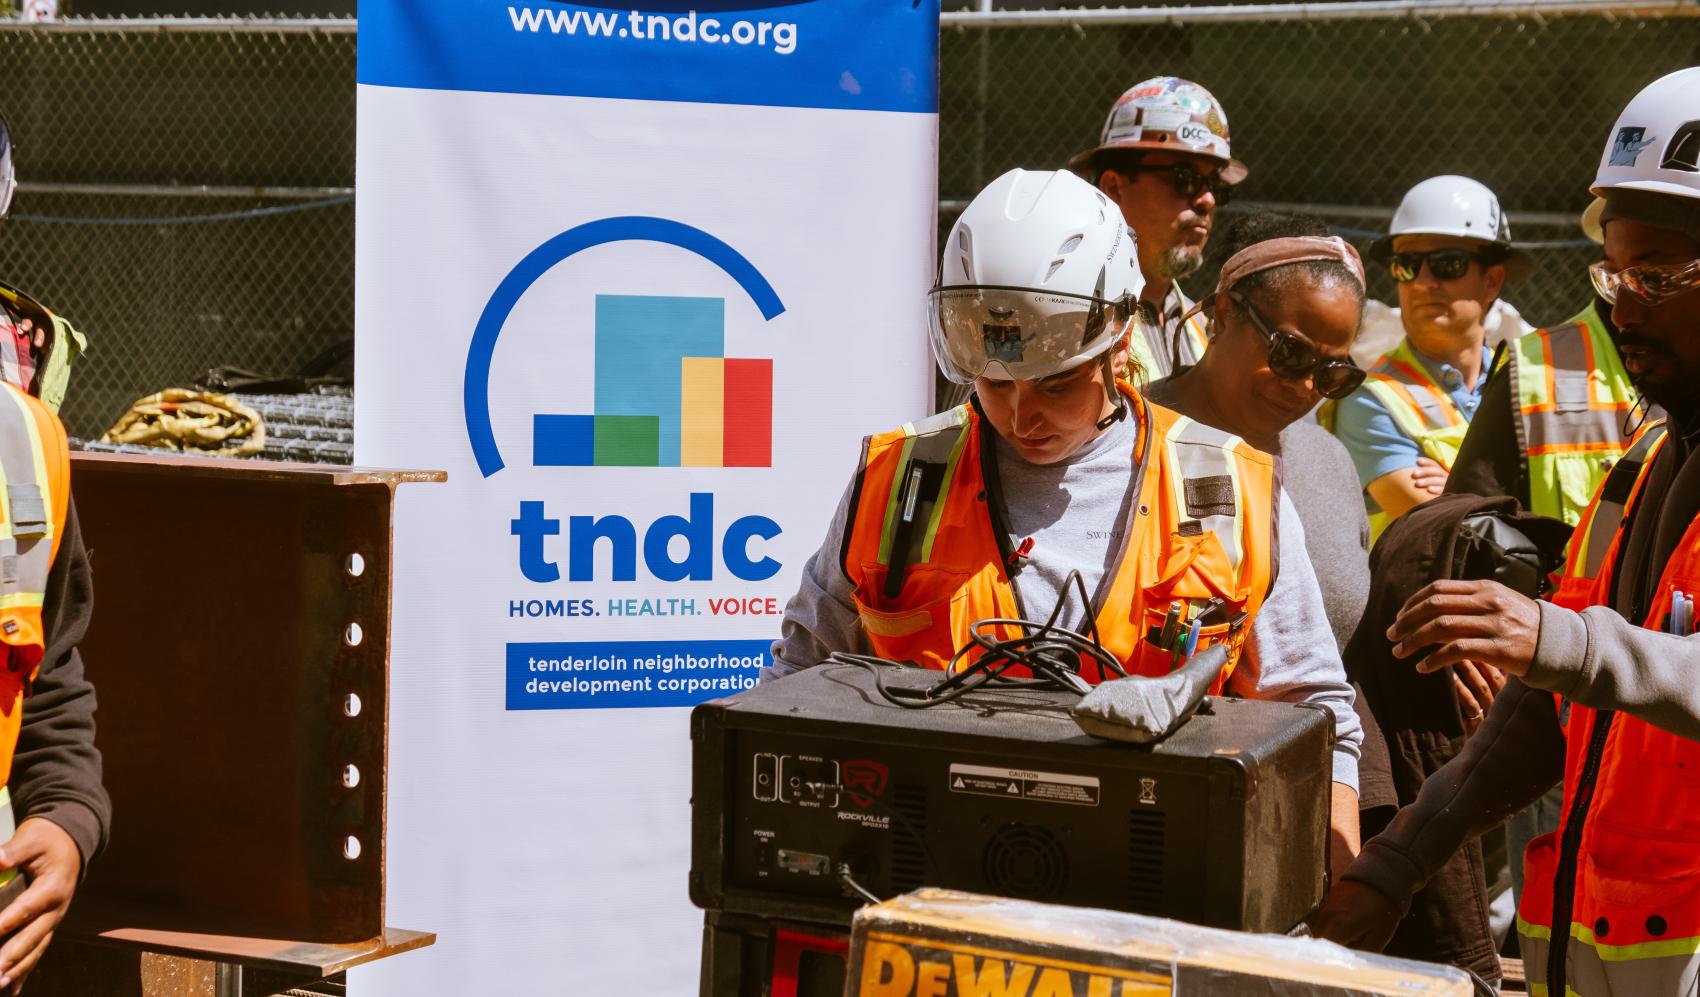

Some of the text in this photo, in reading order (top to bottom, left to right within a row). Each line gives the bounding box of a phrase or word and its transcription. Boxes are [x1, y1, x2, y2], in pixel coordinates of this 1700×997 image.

[508, 7, 798, 54] www.tndc.org
[510, 492, 783, 583] tndc
[509, 597, 783, 617] HOMES. HEALTH. VOICE.
[528, 652, 764, 673] tenderloin neighborhood
[525, 676, 653, 696] development
[1008, 770, 1039, 780] CAUTION
[837, 811, 890, 823] ROCKVILLE
